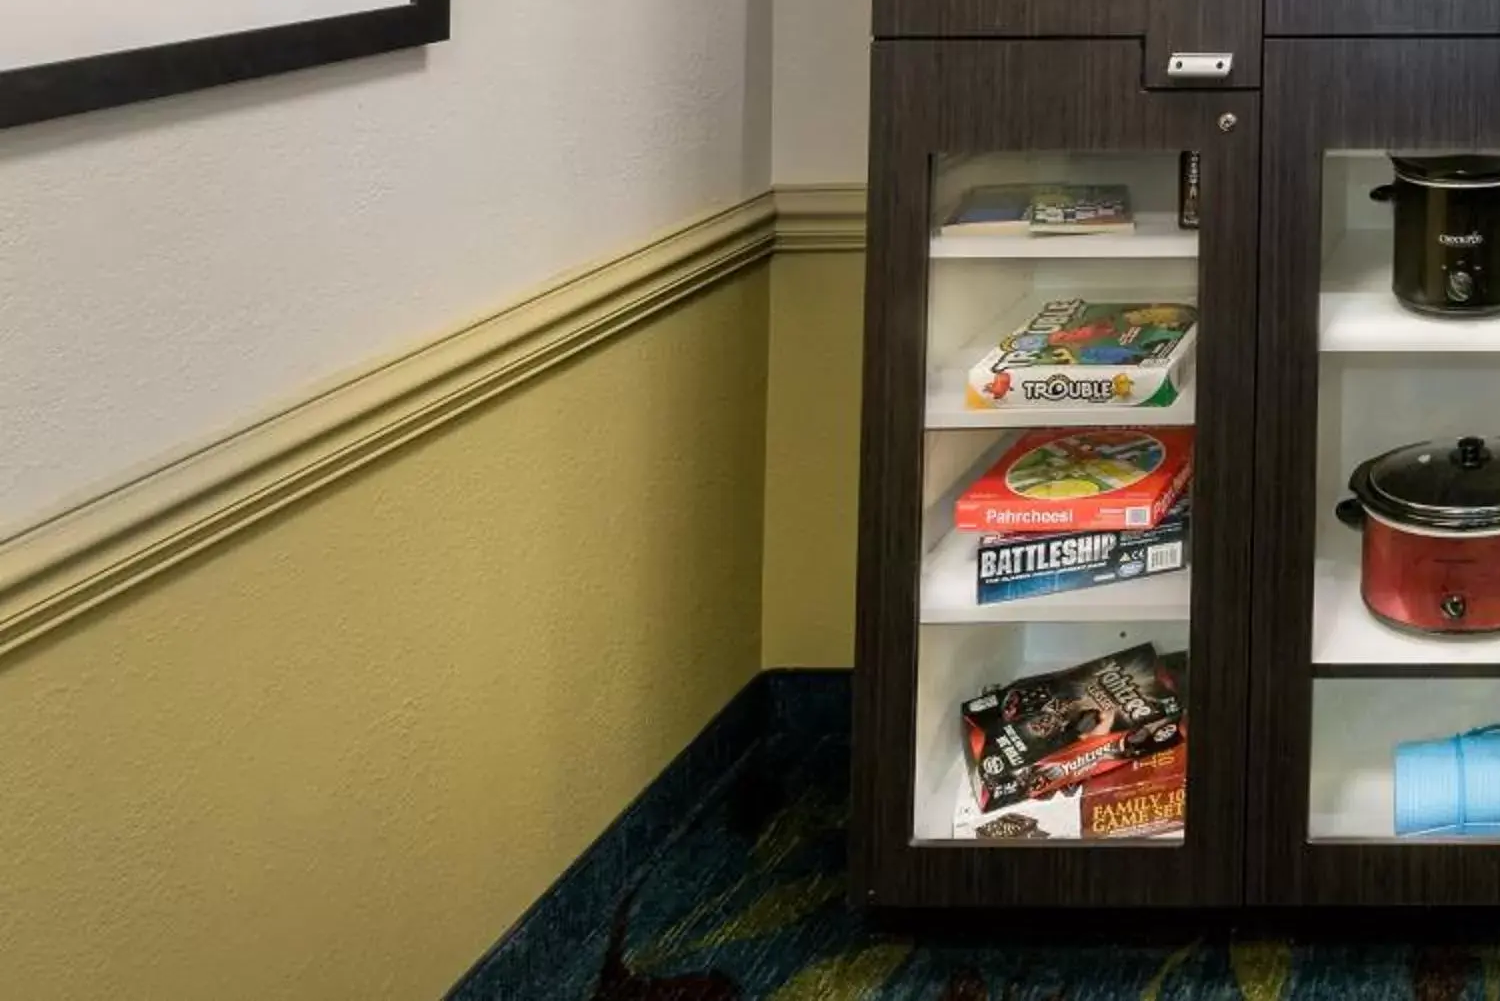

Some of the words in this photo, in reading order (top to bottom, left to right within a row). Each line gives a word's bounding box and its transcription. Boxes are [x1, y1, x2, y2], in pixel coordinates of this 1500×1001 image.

[1021, 375, 1114, 401] TROUBLE
[979, 533, 1118, 579] BATTLESHIP
[1092, 792, 1164, 820] FAMILY
[1092, 809, 1150, 833] GAME
